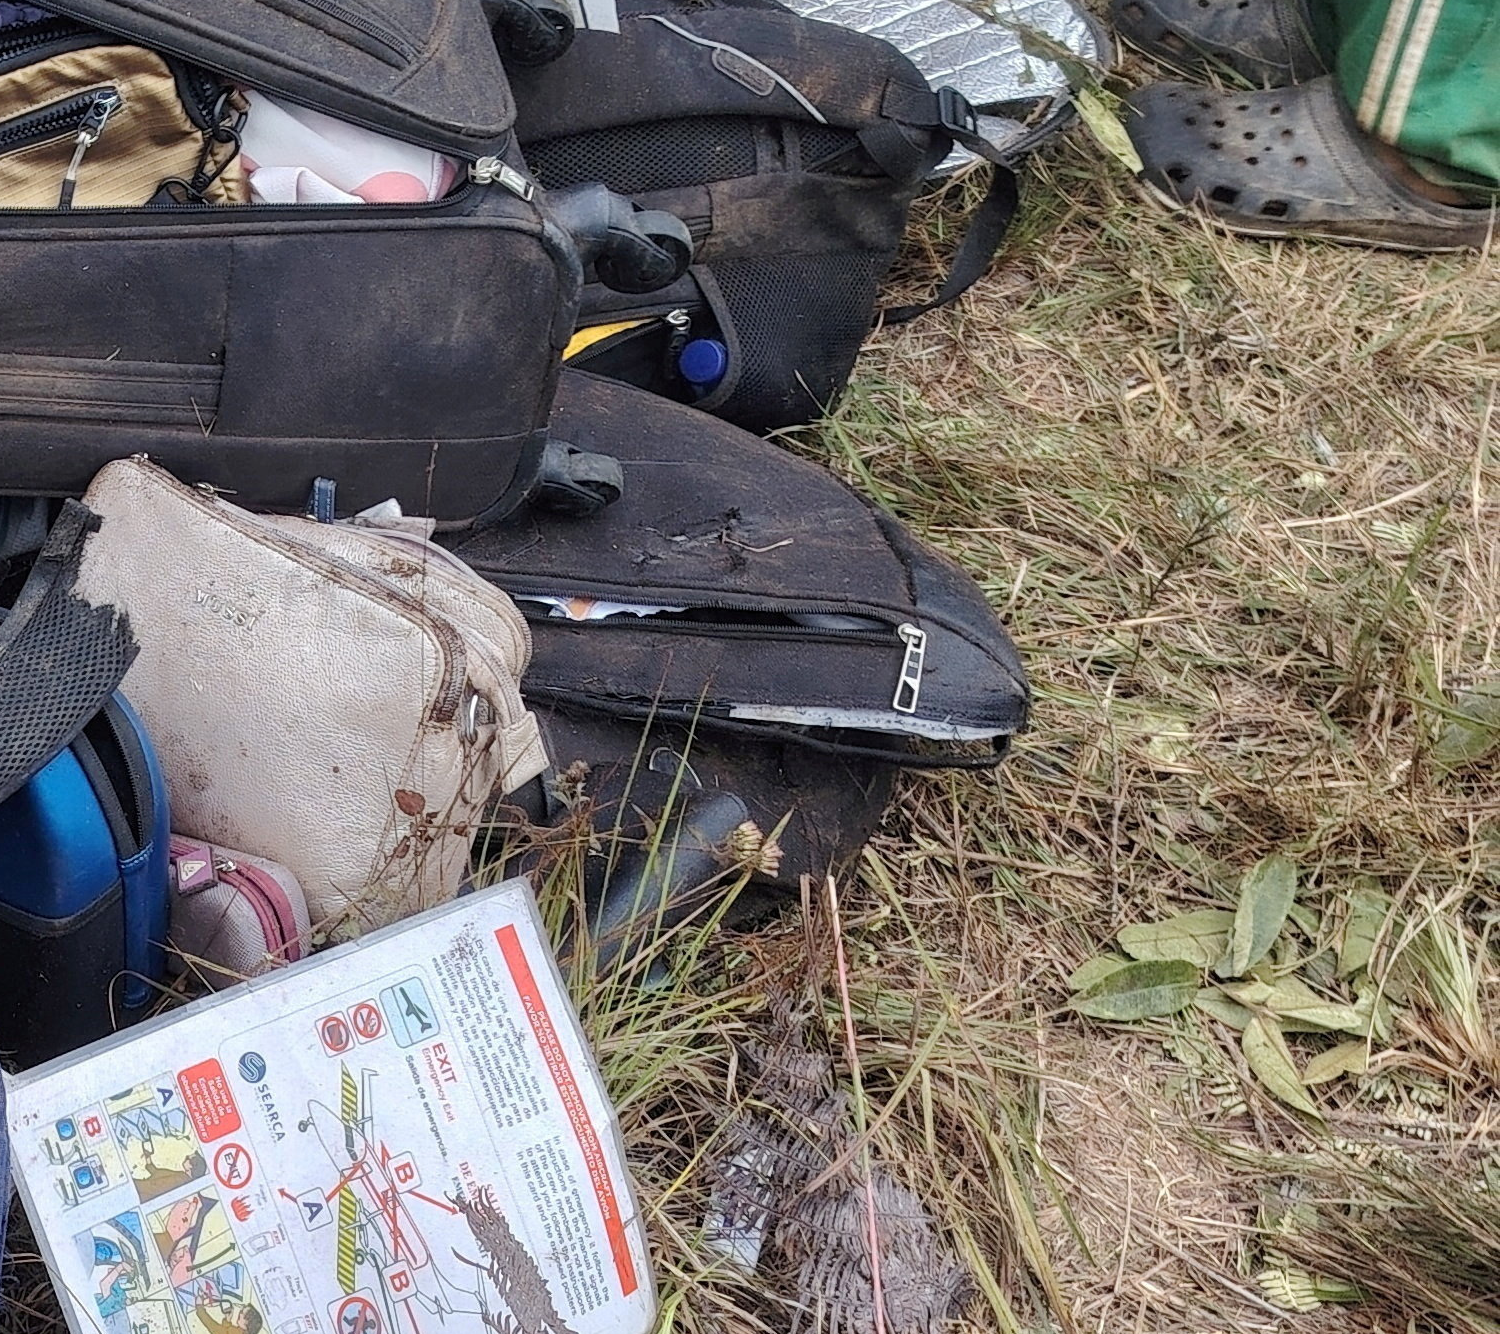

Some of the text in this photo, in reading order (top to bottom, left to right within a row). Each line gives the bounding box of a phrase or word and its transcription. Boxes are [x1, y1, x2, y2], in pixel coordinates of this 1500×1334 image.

[455, 1014, 466, 1028] de
[488, 1004, 497, 1012] y
[494, 1013, 505, 1029] las
[481, 954, 494, 978] caso
[490, 977, 502, 993] de
[527, 1074, 543, 1096] siga
[538, 1096, 550, 1113] las
[404, 1053, 427, 1100] Salida de
[431, 1041, 457, 1087] EXIT
[457, 997, 473, 1020] siga
[469, 1023, 481, 1040] las
[504, 1113, 515, 1127] de
[473, 1011, 483, 1025] no
[508, 1102, 522, 1125] para
[155, 1082, 176, 1108] A
[206, 1078, 226, 1117] Salida de
[213, 1075, 224, 1090] No
[218, 1089, 228, 1105] use
[420, 1046, 455, 1123] Emergency Exit
[522, 994, 540, 1029] FAVOR
[535, 1027, 546, 1044] NO
[541, 1042, 563, 1084] RETIRAR
[558, 1084, 573, 1109] ESTE
[568, 1108, 595, 1168] DOCUMENTO
[591, 1168, 601, 1189] DEL
[195, 1076, 221, 1126] Emergencia
[195, 1093, 206, 1113] caso
[202, 1114, 212, 1126] de
[256, 1082, 287, 1142] SEARCA
[521, 1106, 532, 1120] de
[536, 1010, 612, 1199] PLEASE DO NOT REMOVE FROM AIRCRAFT
[82, 1114, 103, 1139] B
[534, 1141, 544, 1154] of
[538, 1153, 549, 1170] the
[557, 1148, 569, 1172] case
[222, 1151, 242, 1183] EXIT
[393, 1159, 415, 1186] B
[566, 1173, 575, 1186] of
[301, 1193, 326, 1224] A
[519, 1160, 532, 1180] this
[526, 1179, 541, 1203] card
[535, 1202, 547, 1223] and
[542, 1222, 553, 1240] the
[569, 1187, 591, 1241] emergency
[554, 1197, 574, 1242] members
[529, 1157, 546, 1189] attend
[548, 1211, 565, 1245] follows
[565, 1261, 588, 1316] instructions
[563, 1194, 575, 1214] and
[571, 1215, 581, 1234] the
[576, 1234, 593, 1271] manual
[587, 1272, 604, 1308] signals
[572, 1251, 583, 1269] not
[590, 1250, 606, 1284] follows
[388, 1267, 411, 1295] B
[577, 1268, 595, 1311] available
[601, 1285, 611, 1302] the
